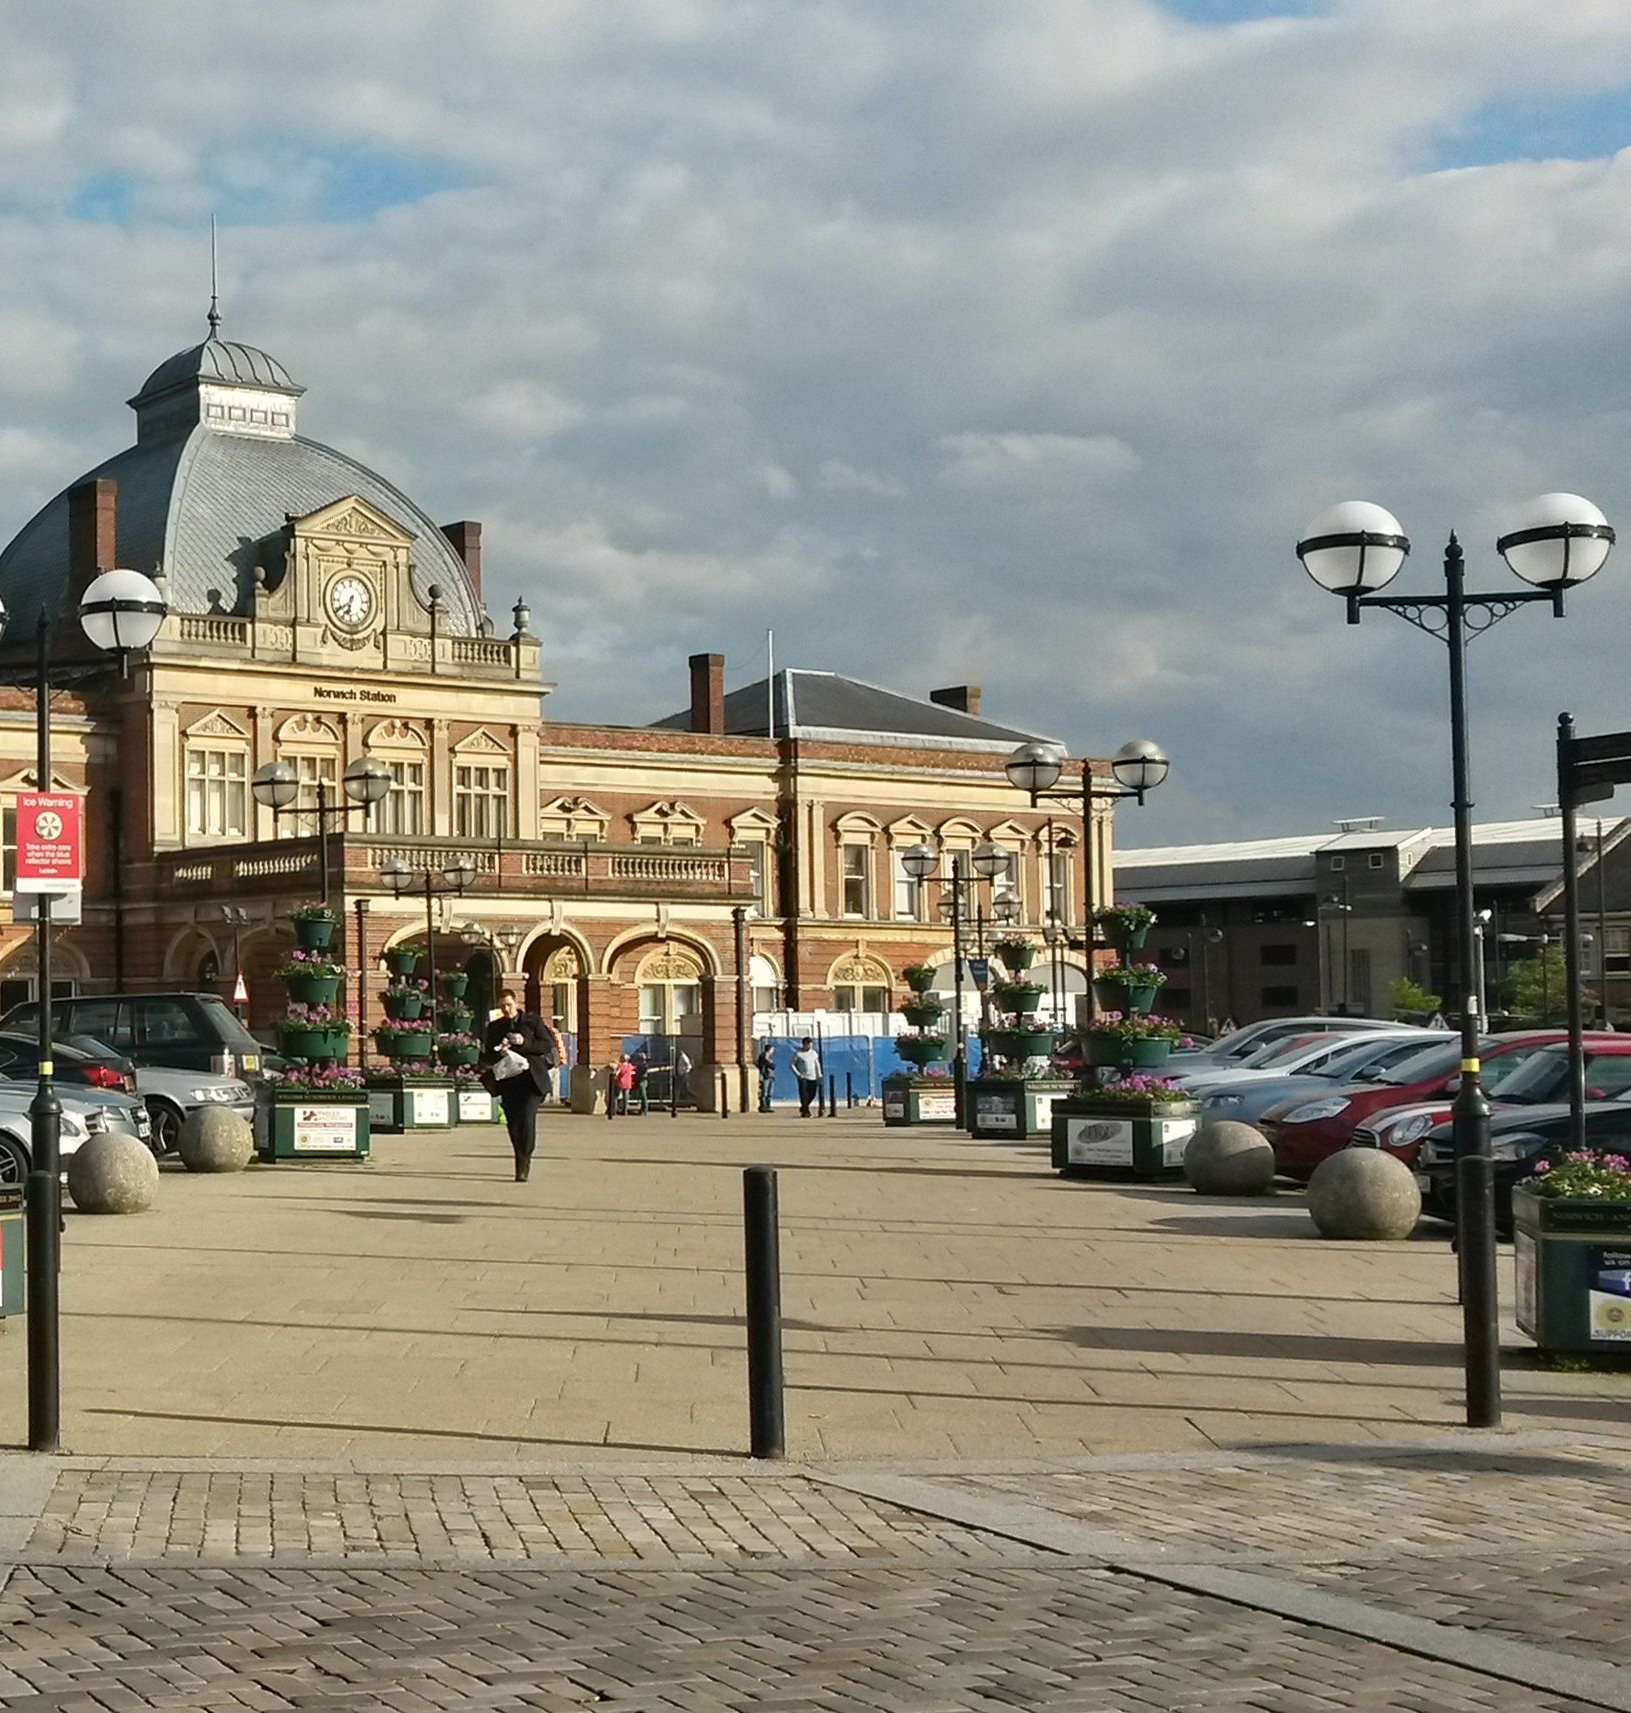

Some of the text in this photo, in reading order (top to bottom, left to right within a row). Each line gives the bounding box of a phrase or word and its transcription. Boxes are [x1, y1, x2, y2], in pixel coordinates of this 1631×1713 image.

[313, 686, 397, 703] Norwich Station
[23, 797, 73, 809] Ice Warning
